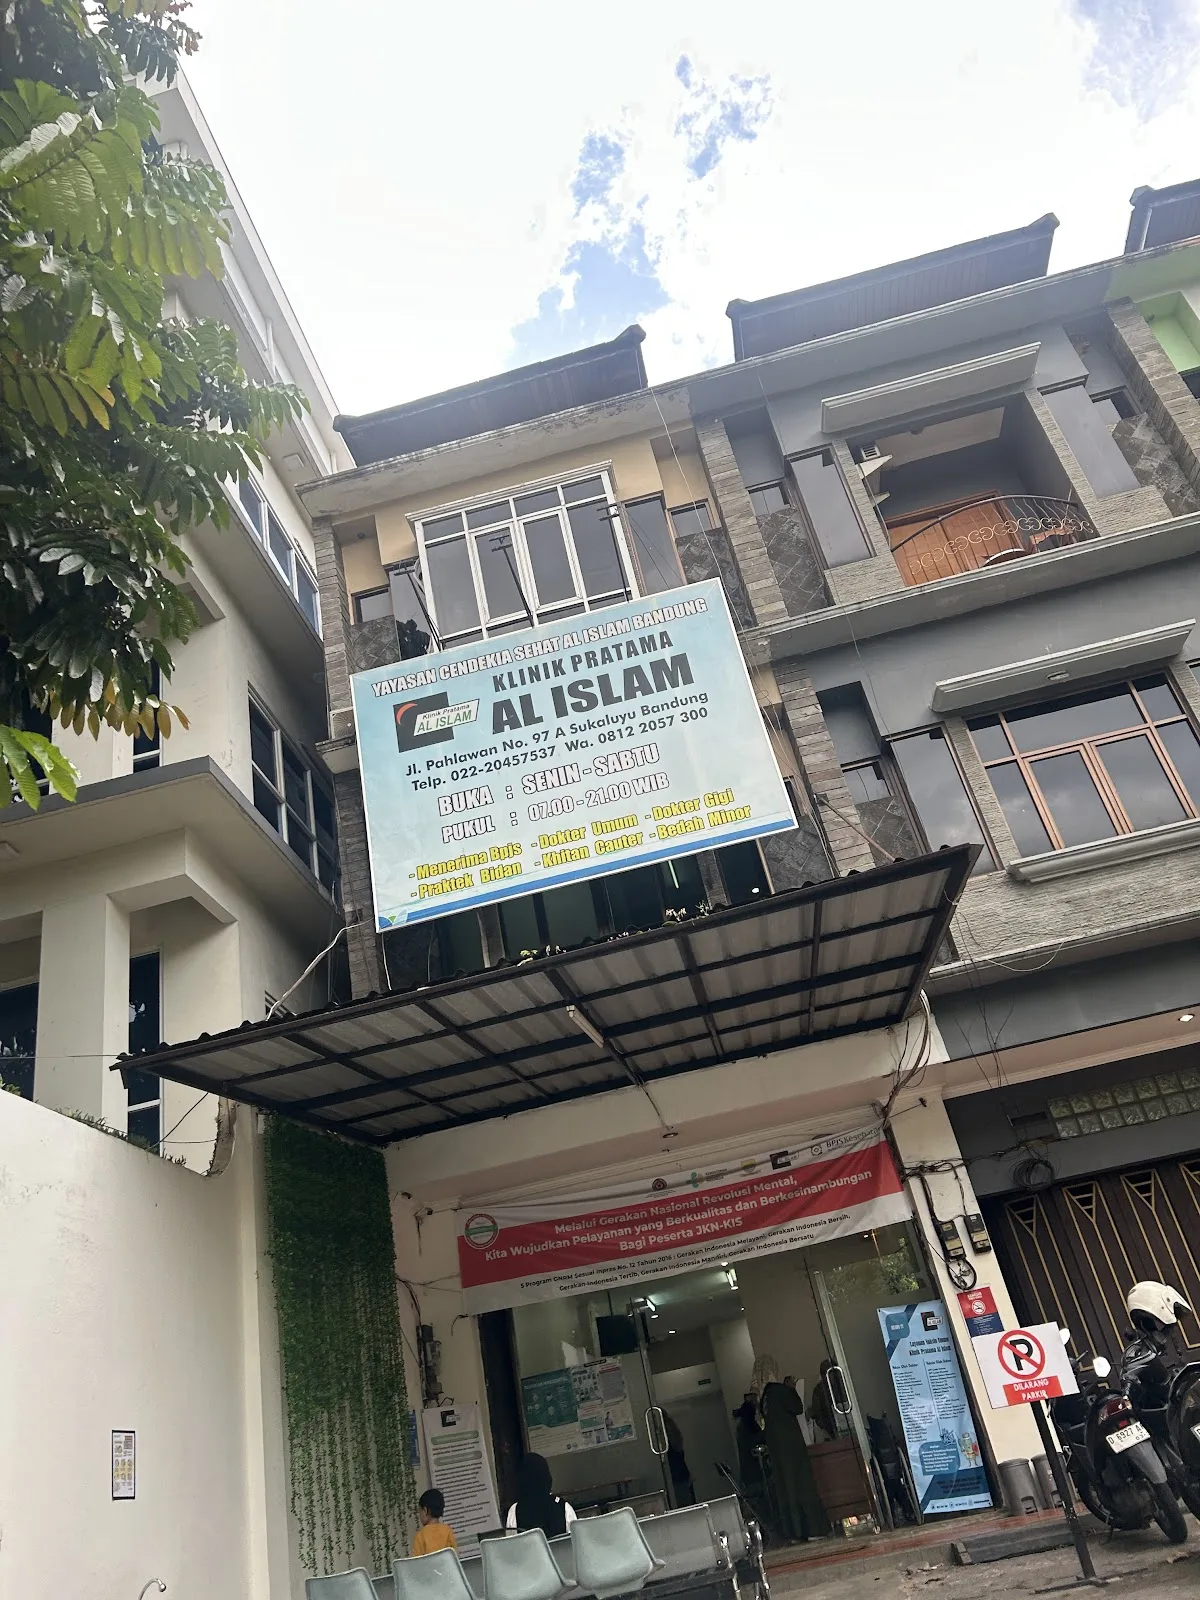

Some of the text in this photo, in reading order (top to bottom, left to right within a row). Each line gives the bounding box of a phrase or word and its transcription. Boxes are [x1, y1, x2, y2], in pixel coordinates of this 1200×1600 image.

[371, 598, 709, 698] YAYASAN CENDEKIA SEHAT AL ISLAM BANDUNG
[492, 630, 674, 693] KLINIK PRATAMA
[416, 709, 472, 733] AL ISLAM
[422, 703, 470, 720] Klinik Pratama
[492, 652, 695, 735] AL ISLAM
[405, 692, 709, 777] Jl. Pahlawan No. 97 A Sukaluyu Bandung
[411, 707, 709, 792] Telp. 022-20457537 Wa. 0812 2057 300
[437, 784, 495, 817] BUKA
[521, 762, 582, 795] SENIN
[592, 742, 660, 777] SABTU
[441, 815, 497, 844] PUKUL
[527, 795, 575, 822] 07.00
[584, 781, 633, 808] 21.00
[631, 772, 670, 796] WIB
[479, 861, 523, 884] Bidan
[594, 831, 644, 856] Cauter
[706, 804, 752, 828] Minor
[489, 842, 523, 863] Bpjs
[591, 813, 639, 836] Umum
[703, 787, 735, 809] Gigi
[485, 1249, 508, 1262] Kita
[509, 1238, 571, 1257] Wujudkan
[571, 1226, 632, 1246] Pelayanan
[633, 1220, 664, 1237] yang
[666, 1204, 733, 1227] Berkualitas
[735, 1199, 758, 1212] dan
[759, 1170, 873, 1207] Berkesinambungan
[554, 1174, 798, 1235] Melalui Gerakan Nasional Revolusi Mental,
[620, 1216, 744, 1252] Bagi Peserta JKN-KIS
[525, 1277, 552, 1289] Program
[637, 1258, 657, 1267] Tahun
[658, 1254, 673, 1262] 2016
[676, 1249, 704, 1259] Gerakan
[704, 1241, 736, 1253] Indonesia
[768, 1227, 795, 1238] Gerakan
[795, 1219, 828, 1232] Indonesia
[828, 1213, 851, 1224] Bersih,
[559, 1233, 815, 1292] Gerakan Indonesia Tertib, Gerakan Indonesia Mandiri, Gerakan Indonesia Bersatu
[1013, 1378, 1049, 1392] DILARANG
[1021, 1389, 1048, 1400] PARKIR
[1115, 1427, 1134, 1441] 6927
